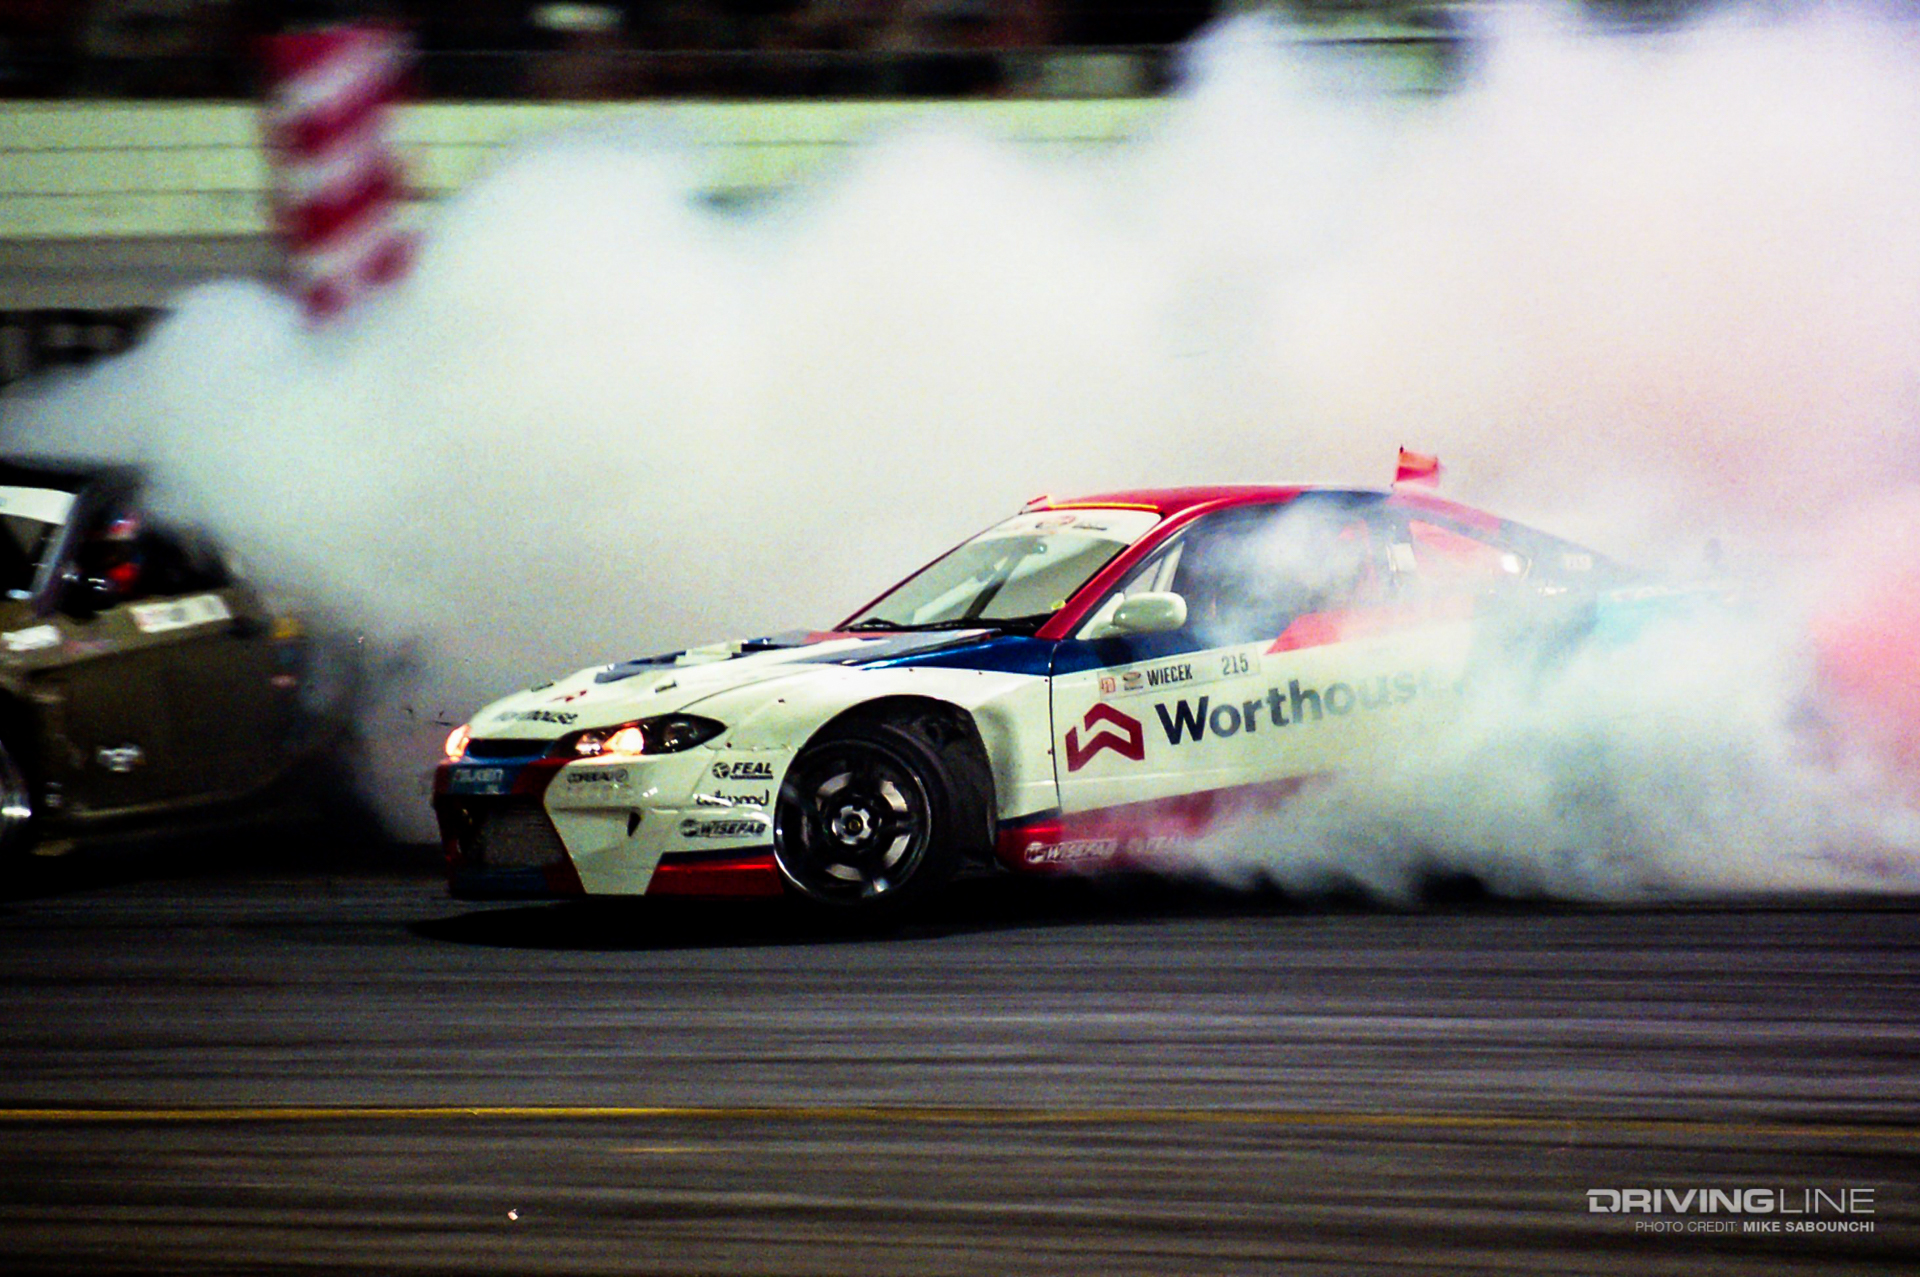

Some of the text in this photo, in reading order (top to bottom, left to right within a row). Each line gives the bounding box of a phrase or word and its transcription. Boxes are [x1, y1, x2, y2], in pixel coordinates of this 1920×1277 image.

[1146, 652, 1249, 687] WIECEK 215
[1154, 668, 1446, 746] Worthous
[731, 761, 773, 775] FEAL
